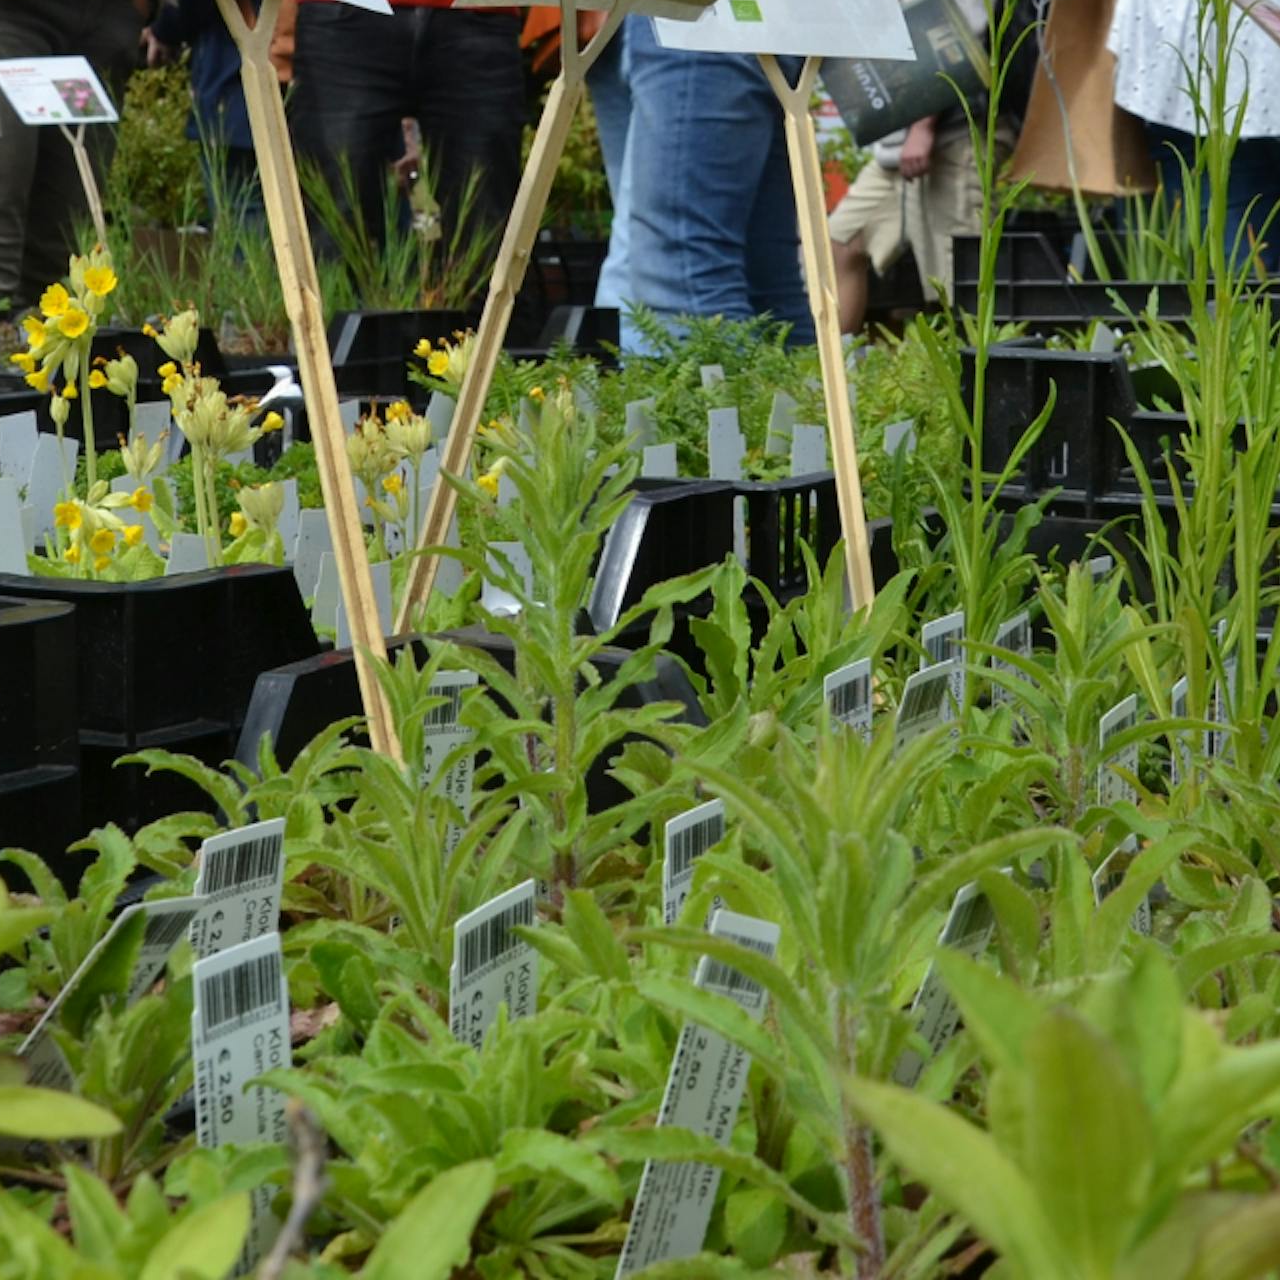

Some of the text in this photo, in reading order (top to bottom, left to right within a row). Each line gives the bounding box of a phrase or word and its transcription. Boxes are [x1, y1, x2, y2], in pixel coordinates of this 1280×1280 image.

[218, 1048, 233, 1124] € 2,50
[254, 1032, 267, 1134] Camanula
[686, 1037, 707, 1090] 2,50
